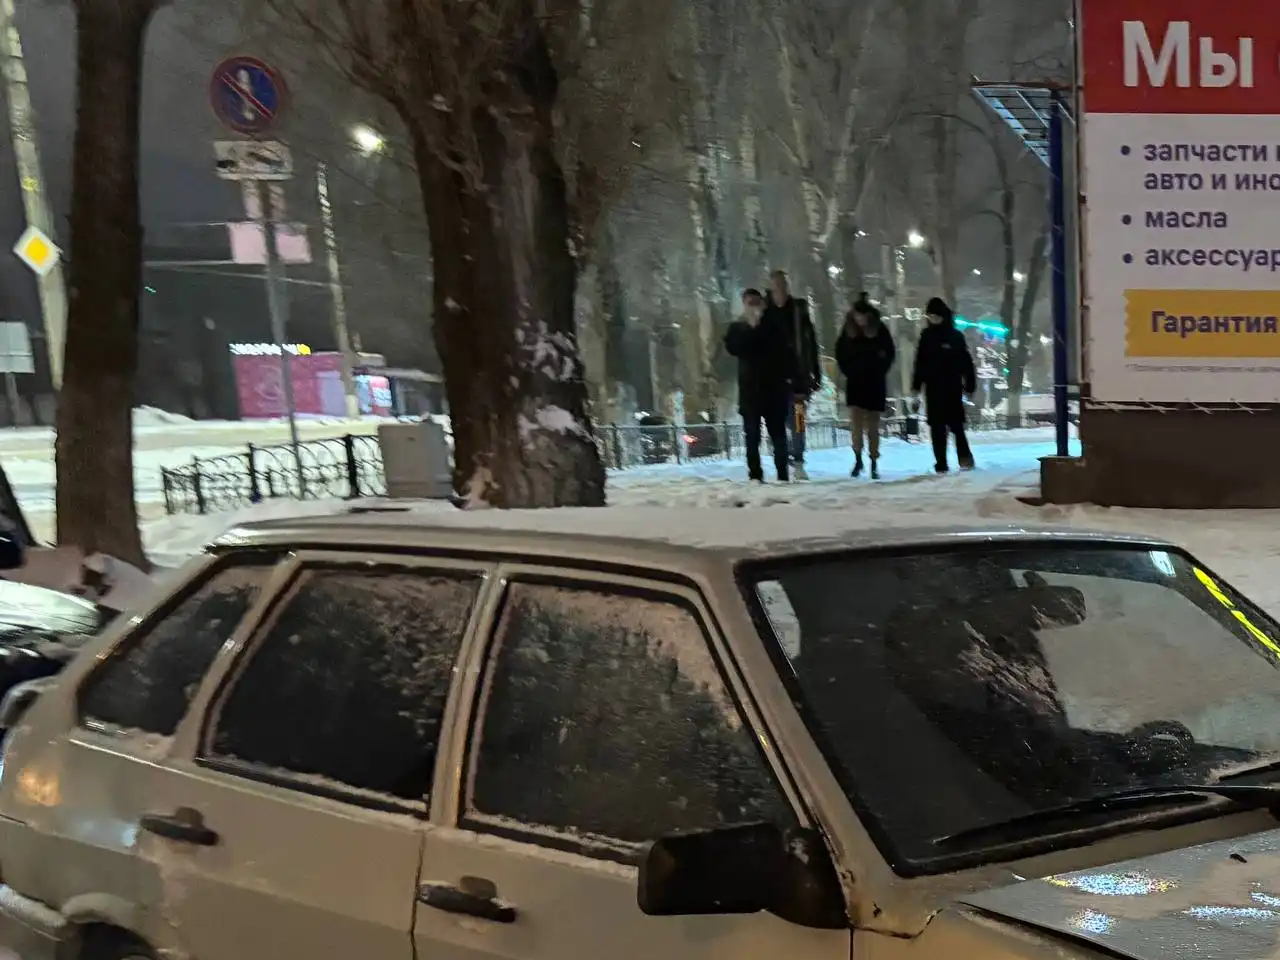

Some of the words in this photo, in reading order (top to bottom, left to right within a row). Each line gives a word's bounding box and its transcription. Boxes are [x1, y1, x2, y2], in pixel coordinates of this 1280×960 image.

[1122, 20, 1254, 88] Мы
[1143, 143, 1268, 162] запчасти
[1144, 172, 1204, 191] авто
[1210, 172, 1228, 191] и
[1144, 210, 1228, 229] масла
[1150, 310, 1279, 338] Гарантия
